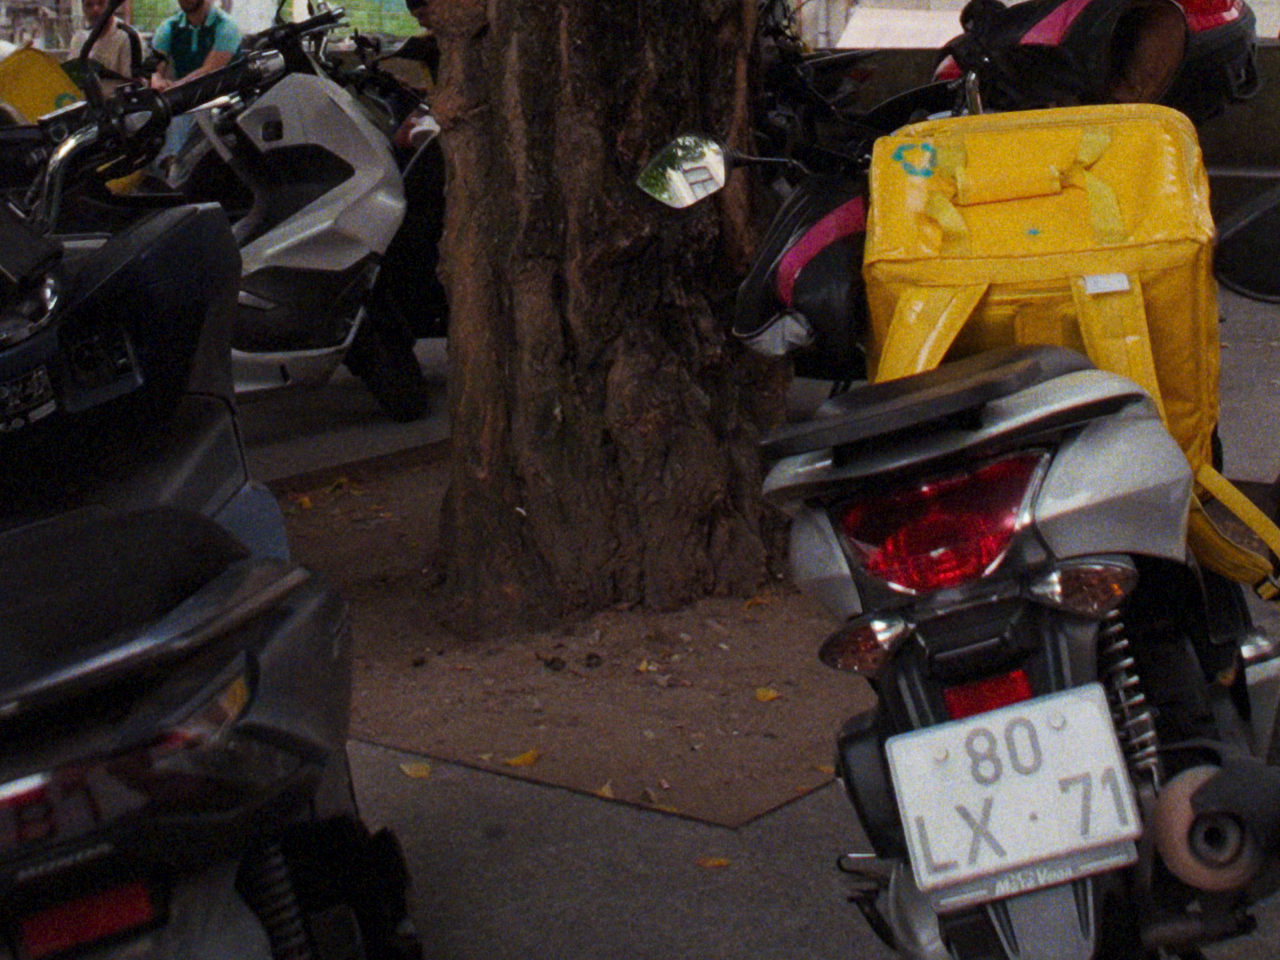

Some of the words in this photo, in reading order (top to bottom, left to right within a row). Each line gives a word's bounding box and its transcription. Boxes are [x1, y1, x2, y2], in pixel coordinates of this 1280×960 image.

[964, 715, 1043, 787] 80
[913, 797, 1008, 876] LX
[1058, 766, 1131, 840] 71
